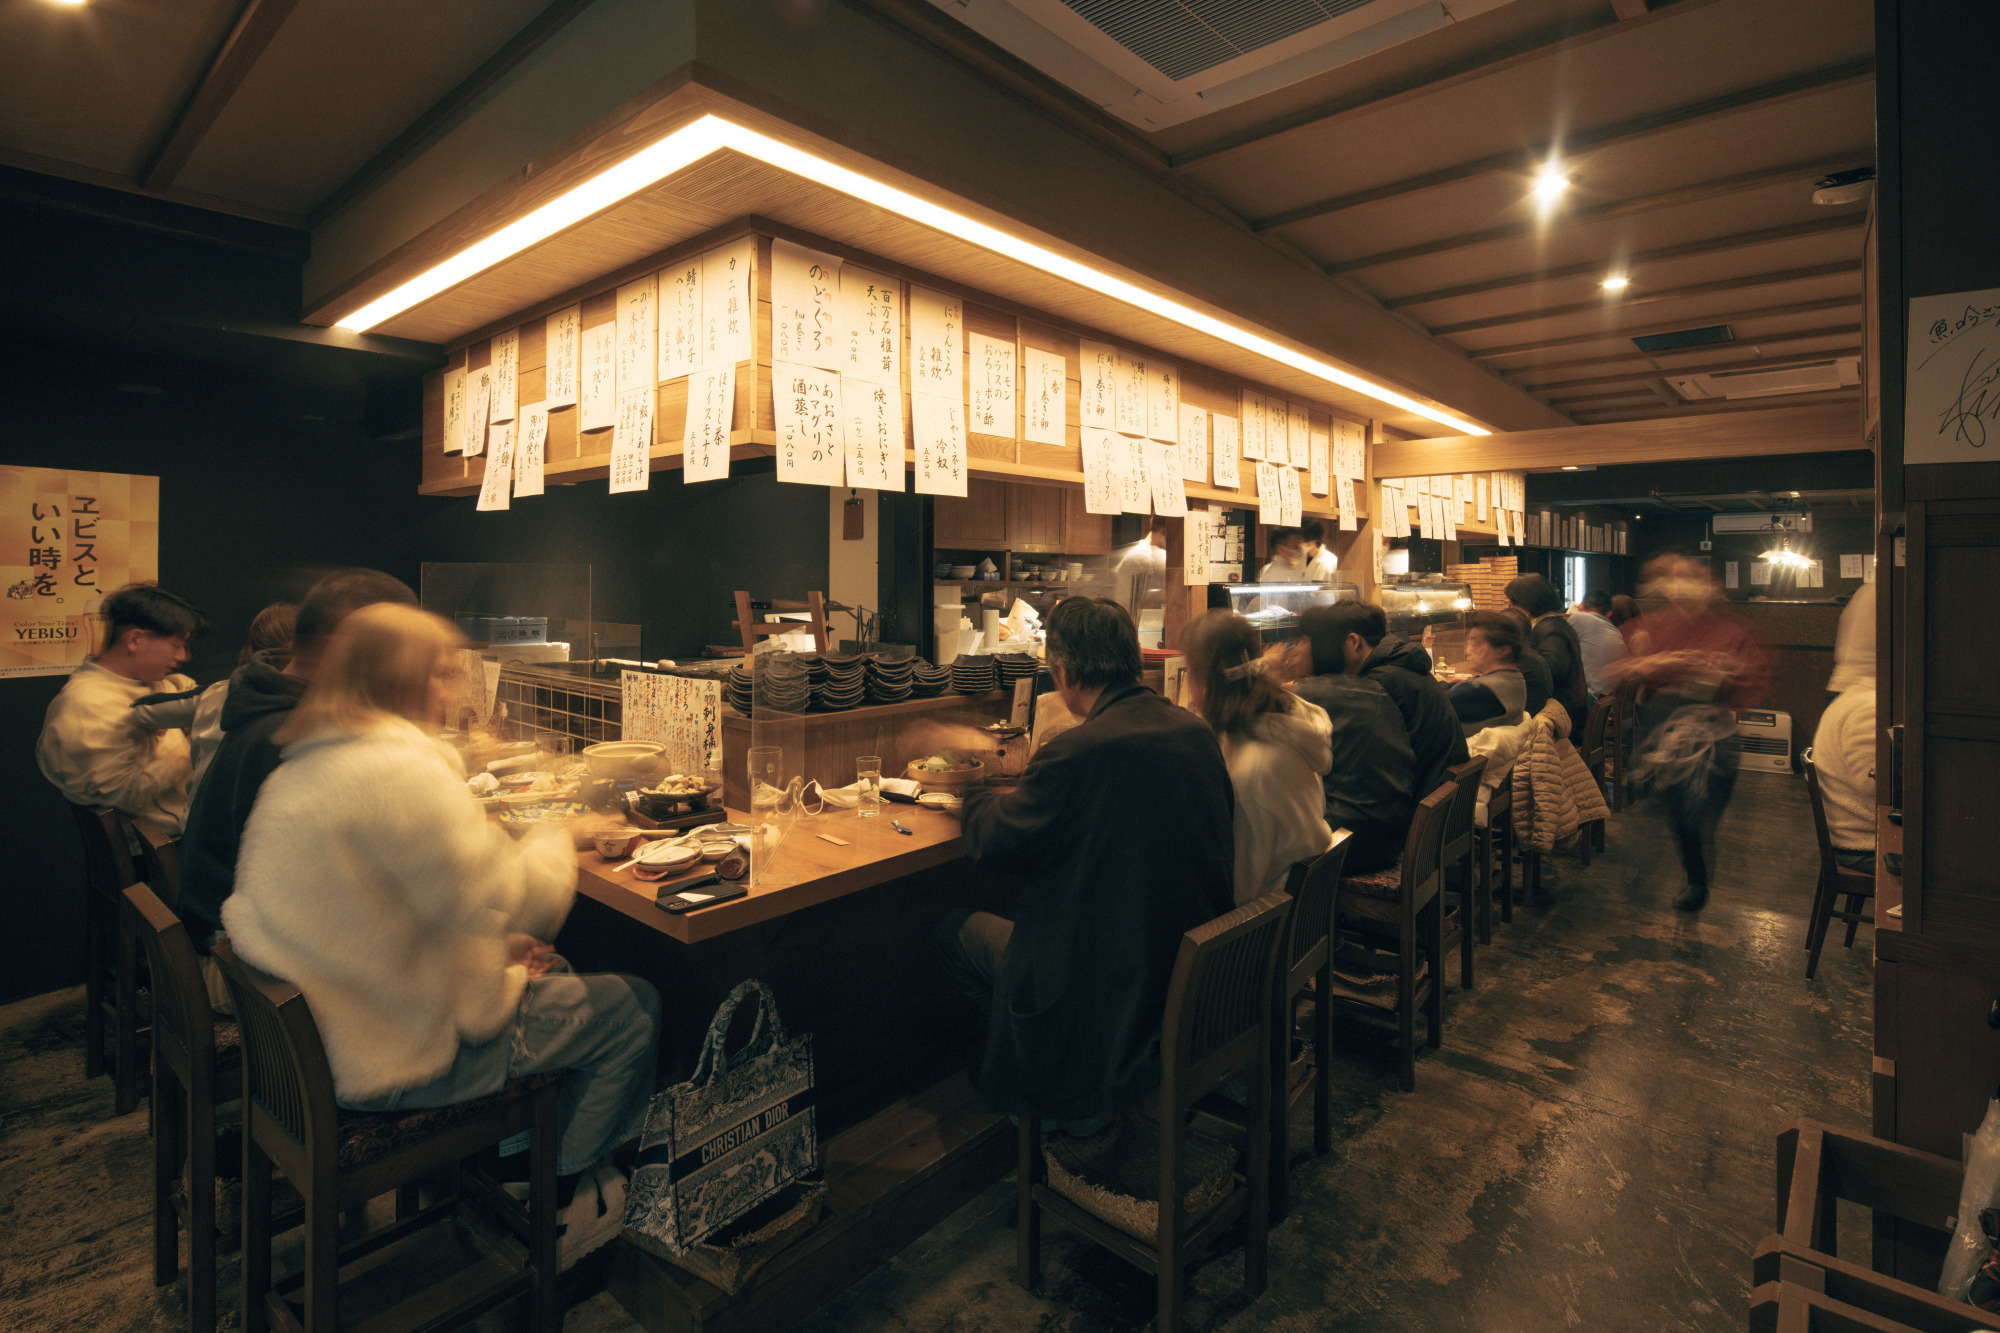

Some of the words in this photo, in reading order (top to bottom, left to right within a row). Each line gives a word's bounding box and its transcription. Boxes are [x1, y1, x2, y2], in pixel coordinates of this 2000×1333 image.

[639, 292, 648, 353] のどぐろ
[728, 256, 739, 335] カニ雑炊
[809, 264, 826, 352] のどぐろ
[867, 285, 878, 336] 天ぷら
[603, 334, 612, 379] 本日の
[630, 298, 638, 363] 一本焼き
[794, 308, 806, 351] 細巻き
[850, 330, 858, 363] 四八〇円
[880, 290, 893, 372] 百万石椎茸
[930, 346, 942, 381] 雑炊
[983, 343, 995, 428] おろしポン酢
[994, 348, 1003, 399] ハラスの
[1003, 348, 1012, 400] サーモン
[1051, 368, 1061, 395] 一番
[1096, 352, 1106, 417] だし巻き卵
[702, 375, 715, 468] アイスモナカ
[713, 368, 727, 446] ほうじ茶
[792, 378, 809, 437] 酒蒸し
[808, 383, 823, 463] ハマグリの
[822, 383, 836, 457] あおさと
[1041, 363, 1050, 431] だし巻き卵
[874, 387, 889, 481] 焼きおにぎり
[936, 438, 949, 470] 冷奴
[29, 502, 64, 604] いい時を。
[71, 496, 103, 595] ヱビスと、
[14, 620, 36, 628] Color
[38, 620, 56, 628] Your
[15, 627, 78, 640] YEBISU
[701, 1116, 760, 1165] CHRISTIAN
[765, 1101, 790, 1130] DIOR
